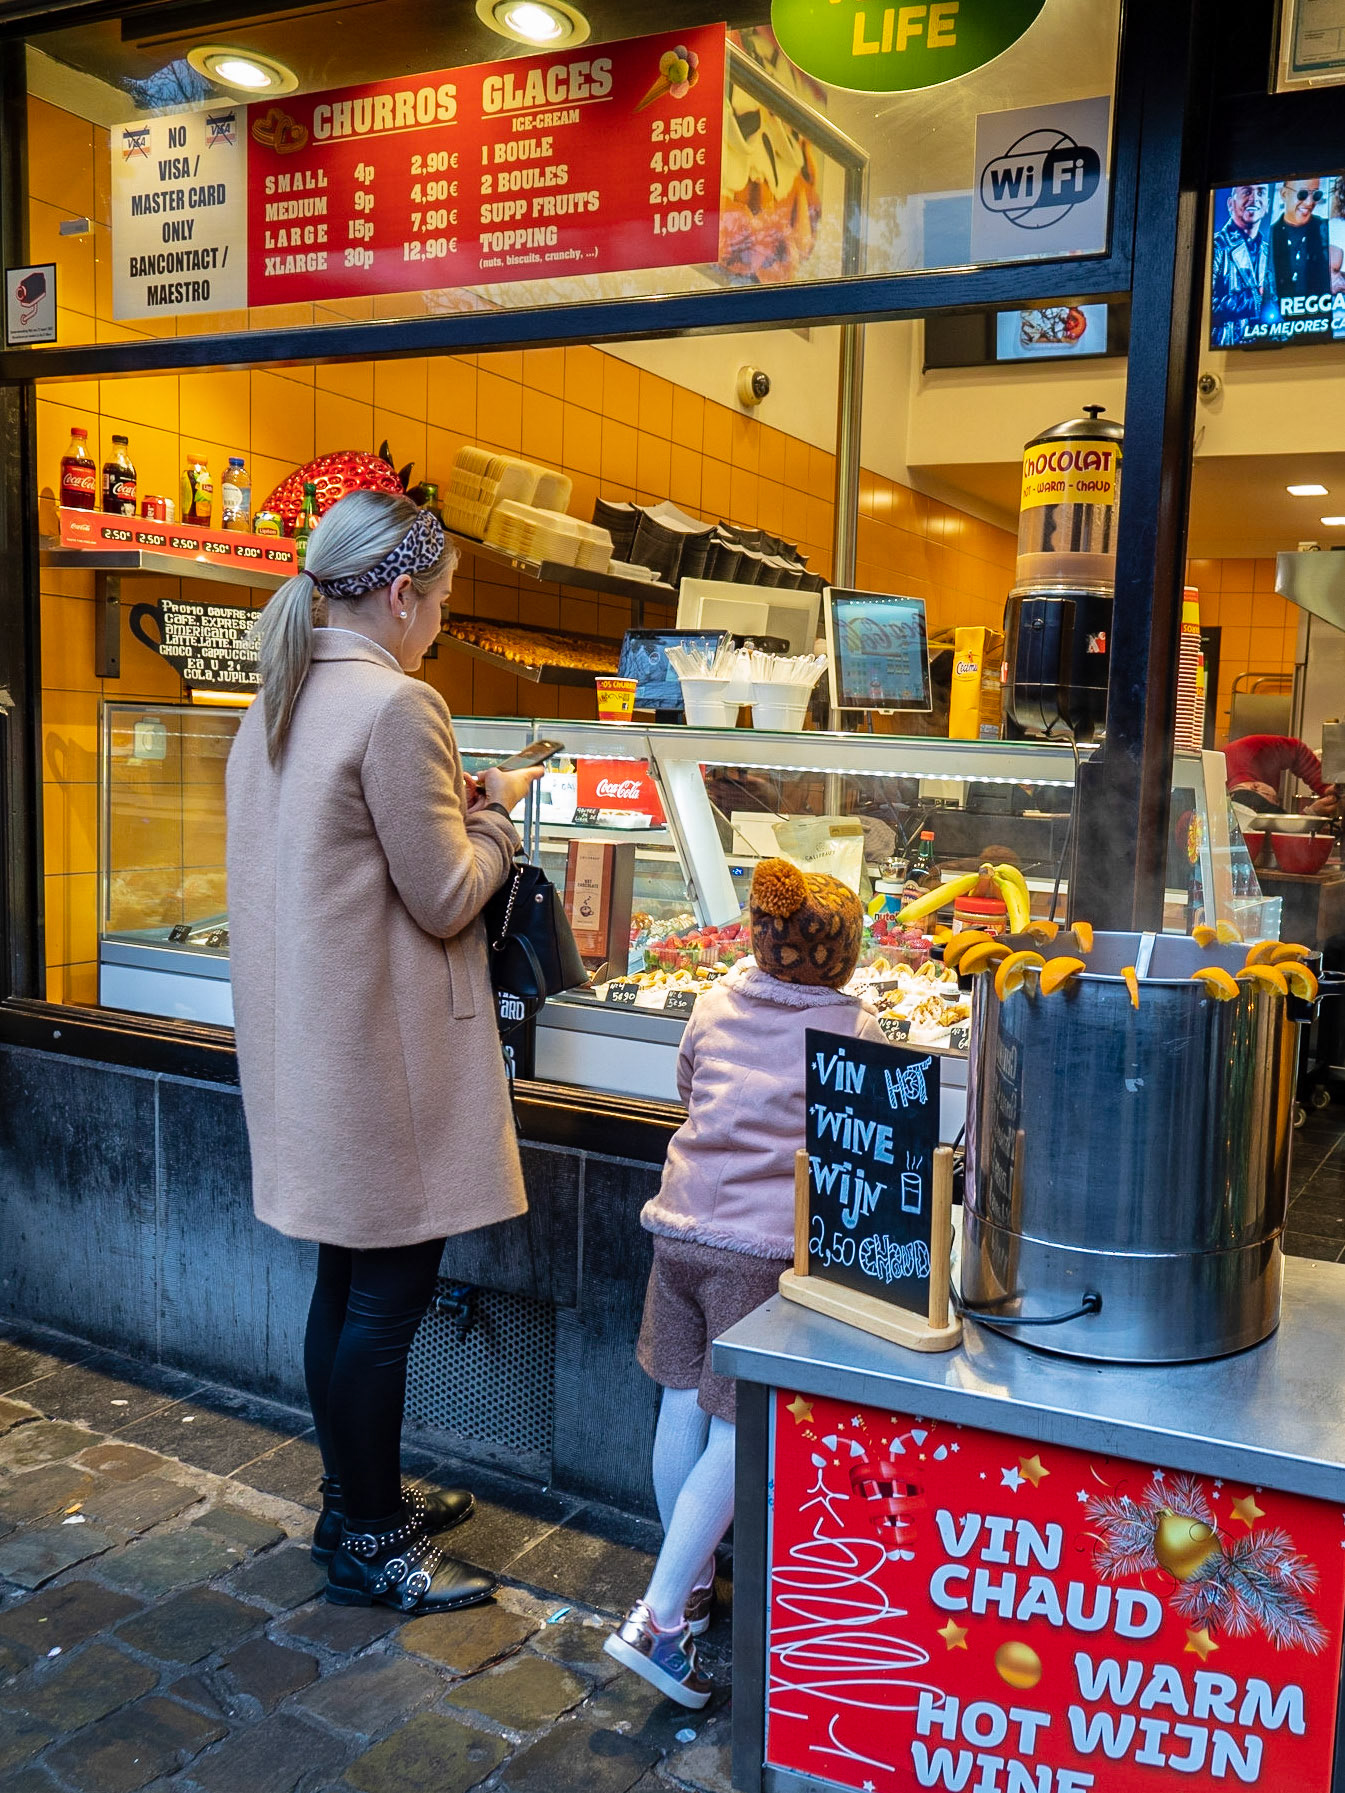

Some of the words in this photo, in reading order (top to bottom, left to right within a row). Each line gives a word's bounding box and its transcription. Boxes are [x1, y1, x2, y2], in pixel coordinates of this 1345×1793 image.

[852, 1, 959, 56] LIFE
[482, 57, 613, 114] GLACES
[313, 83, 457, 139] CHURROS
[511, 109, 580, 132] ICE-CREAM
[168, 125, 187, 149] NO
[651, 115, 707, 143] 2,50€
[410, 151, 459, 176] 2,90€
[481, 146, 488, 165] 1
[494, 136, 553, 163] BOULE
[650, 147, 706, 173] 4,00€
[158, 156, 190, 182] VISA
[265, 168, 328, 195] SMALL
[354, 163, 375, 185] 4p
[480, 174, 492, 195] 2
[497, 164, 568, 194] BOULES
[131, 189, 184, 217] MASTER
[188, 184, 226, 209] CARD
[354, 190, 375, 214] 9p
[410, 180, 459, 204] 4,90€
[649, 178, 705, 204] 2,00€
[265, 196, 328, 222] MEDIUM
[480, 200, 527, 225] SUPP
[532, 190, 600, 219] FRUITS
[162, 219, 195, 244] ONLY
[348, 219, 375, 242] 15p
[410, 209, 458, 233] 7,90€
[652, 209, 704, 236] 1,00€
[264, 223, 328, 249] LARGE
[479, 225, 558, 253] TOPPING
[344, 246, 374, 270] 30p
[403, 237, 458, 262] 12,90€
[479, 258, 504, 269] (nuts,
[506, 253, 542, 266] biscuits,
[544, 248, 583, 261] crunchy,
[129, 248, 218, 278] BANCONTACT
[264, 251, 328, 276] XLARGE
[147, 279, 211, 307] MAESTRO
[1244, 324, 1268, 338] LAS
[1269, 319, 1329, 338] MEJORES
[596, 778, 643, 800] Coca-Cola
[884, 1055, 933, 1110] HOT
[808, 1215, 856, 1268] 2,50
[934, 1507, 1065, 1571] VIN
[928, 1562, 1164, 1640] CHAUD
[1074, 1651, 1307, 1736] WARM
[916, 1690, 1052, 1756] HOT
[1067, 1704, 1264, 1784] WIJN
[911, 1740, 1095, 1793] WINE
